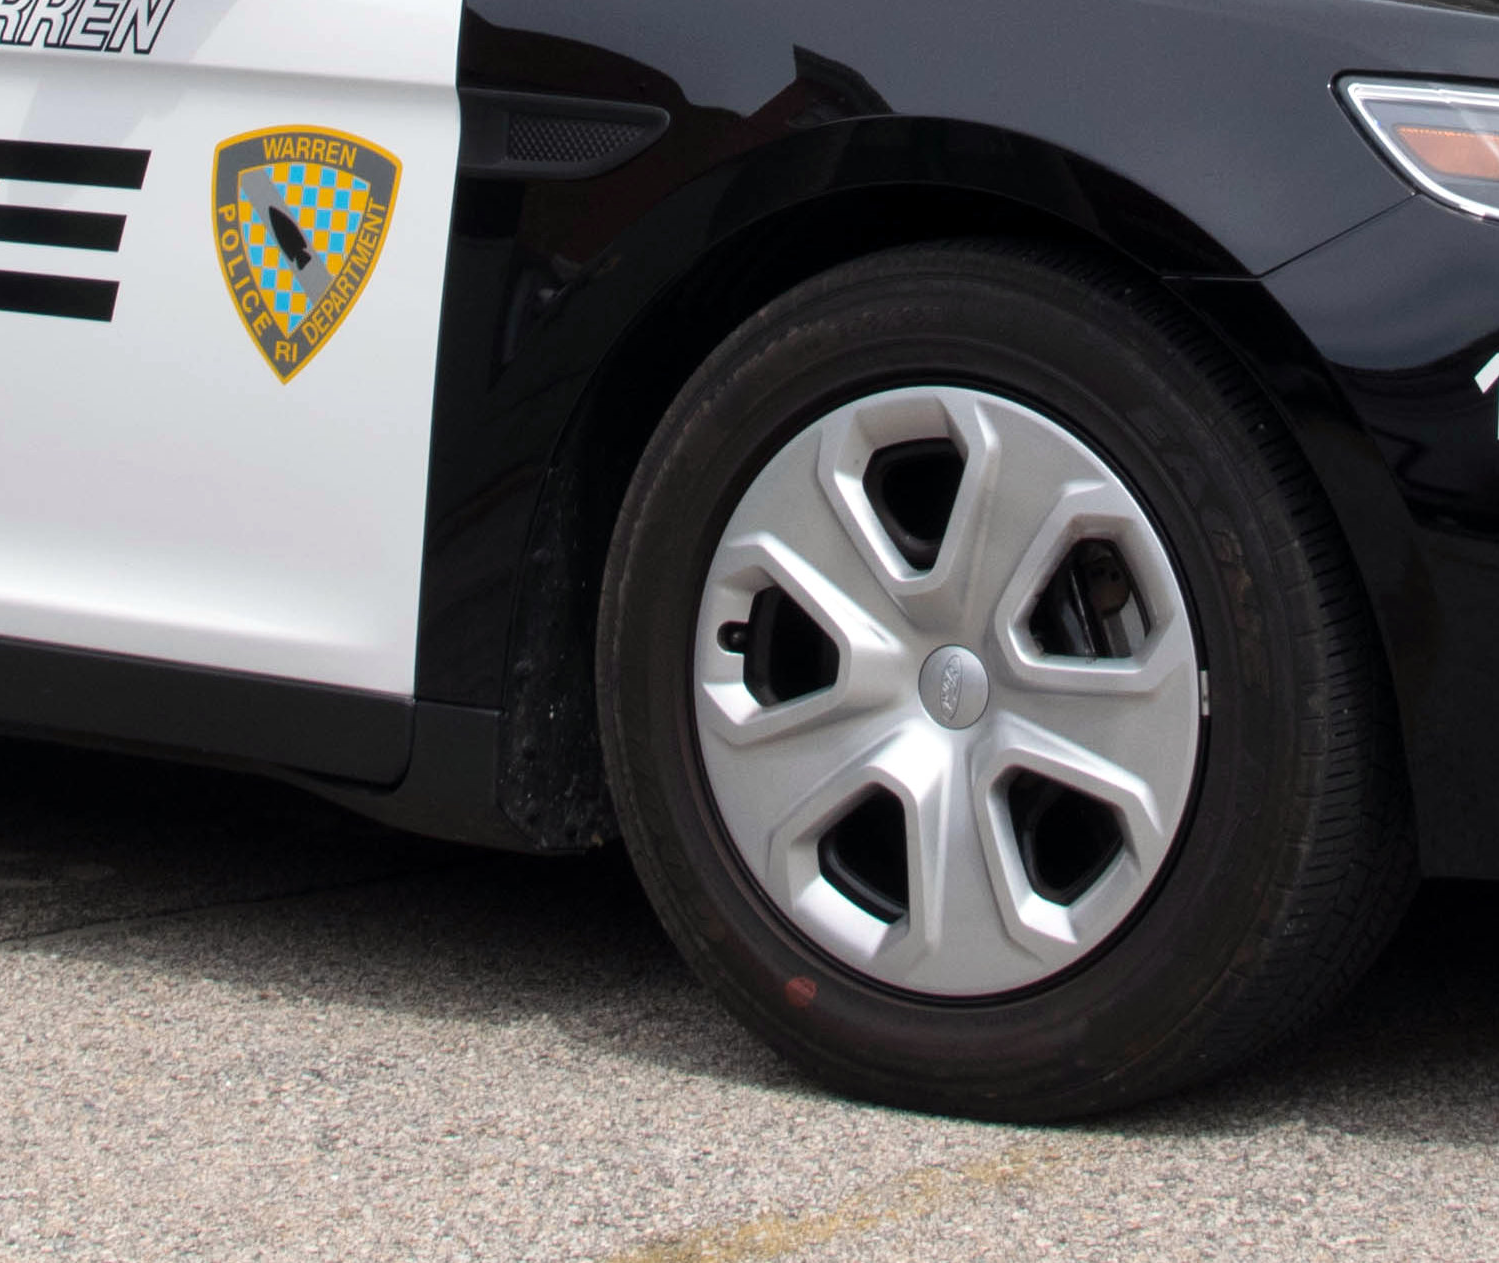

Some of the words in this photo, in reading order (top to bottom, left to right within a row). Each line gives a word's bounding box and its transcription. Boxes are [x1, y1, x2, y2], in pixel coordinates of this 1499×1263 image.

[262, 137, 357, 169] WARREN
[218, 203, 272, 337] POLICE
[302, 197, 387, 346] DEPARTMENT
[274, 340, 298, 363] RI
